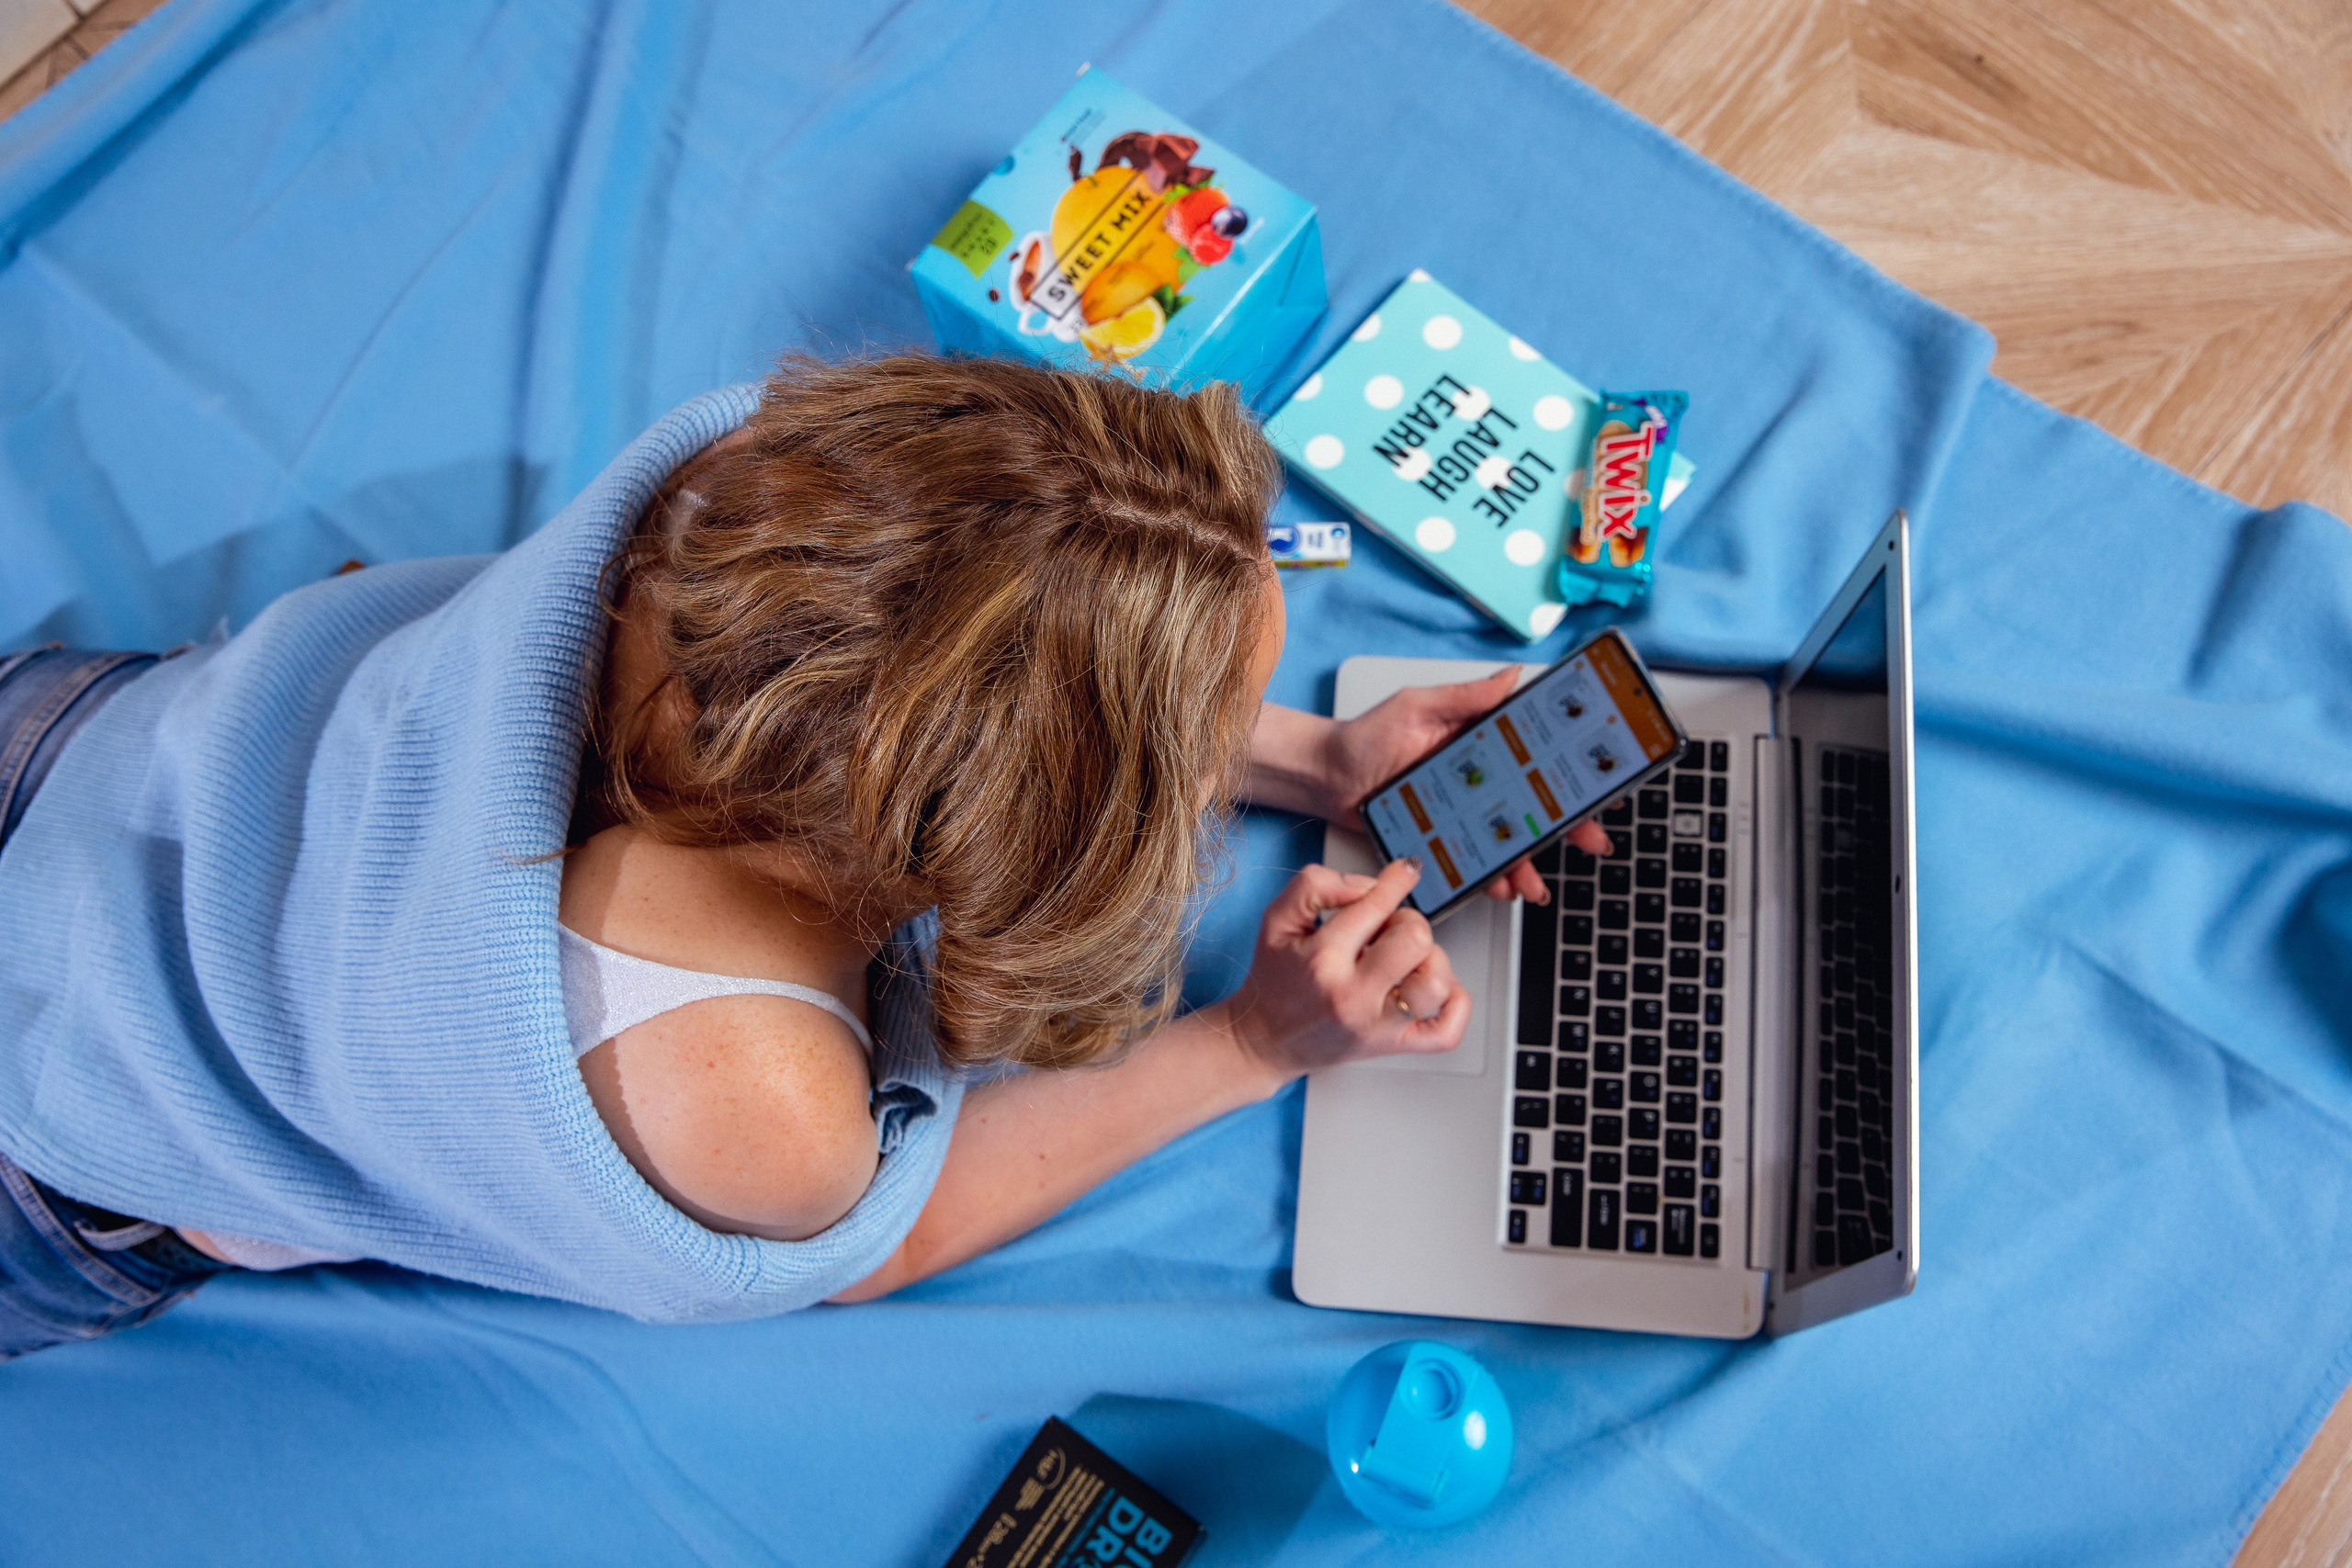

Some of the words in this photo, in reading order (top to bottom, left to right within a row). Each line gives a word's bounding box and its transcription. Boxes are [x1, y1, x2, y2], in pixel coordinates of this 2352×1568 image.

[1047, 232, 1114, 302] SWEET
[1110, 189, 1152, 233] MIX
[1373, 372, 1472, 468] LEARN
[1418, 406, 1518, 503] LAUGH
[1473, 448, 1555, 528] LOVE
[1069, 1495, 1145, 1568] DR
[1112, 1516, 1173, 1568] BI
